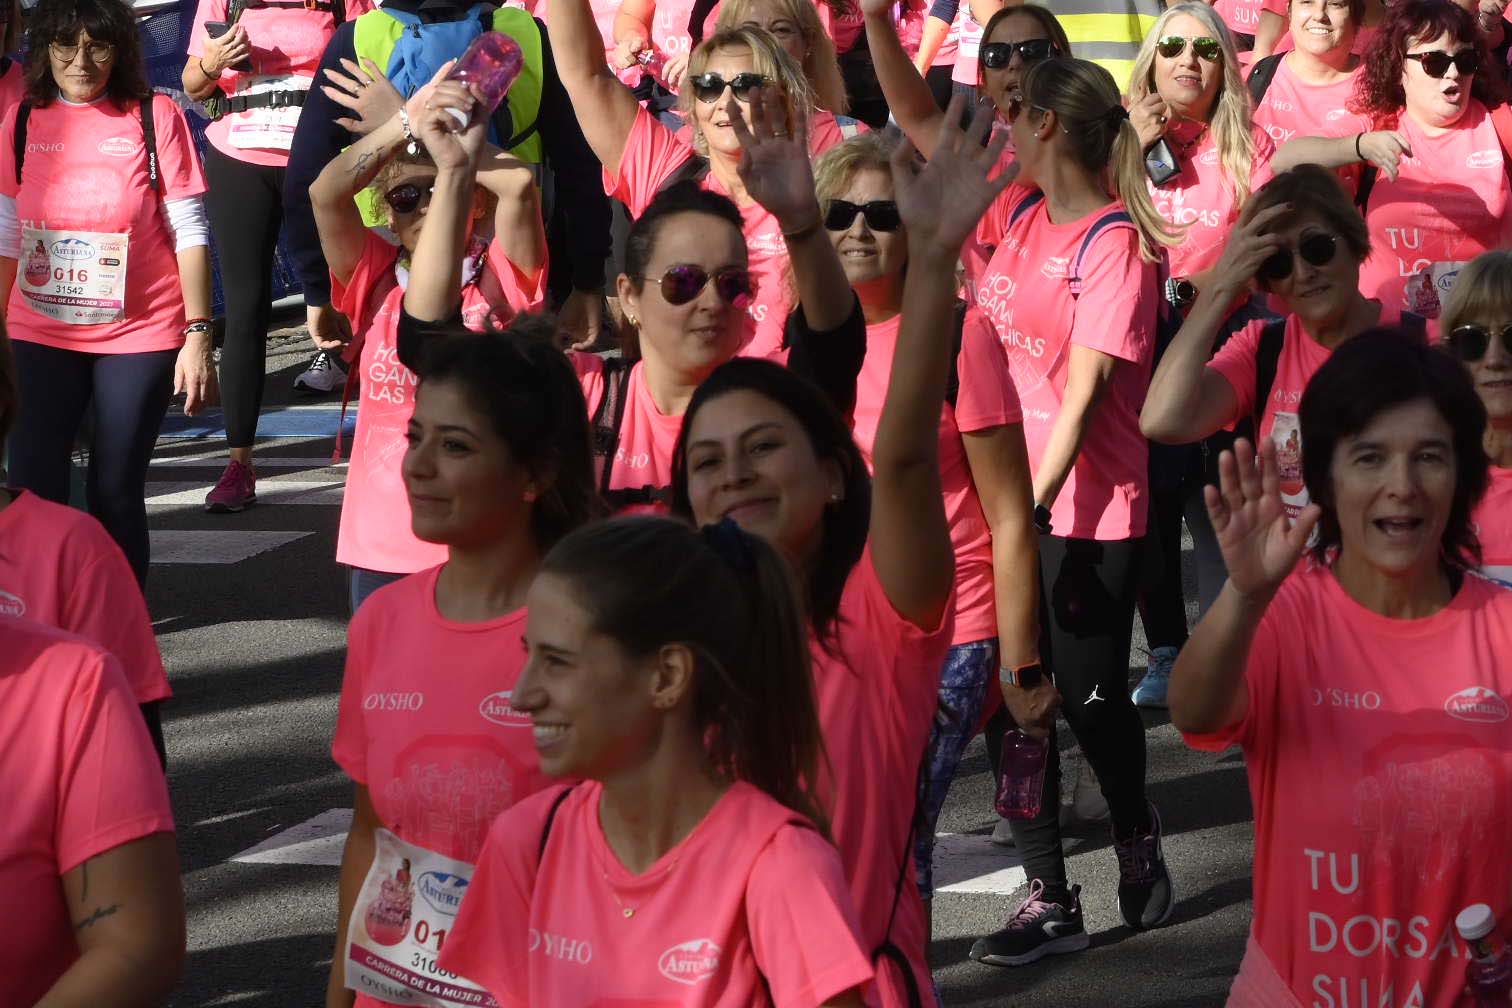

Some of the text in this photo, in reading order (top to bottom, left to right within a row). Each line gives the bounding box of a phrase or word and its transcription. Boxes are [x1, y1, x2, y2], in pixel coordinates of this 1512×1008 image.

[1385, 227, 1419, 249] TU
[54, 269, 88, 283] 016
[56, 285, 84, 295] 31542
[374, 342, 401, 366] HO
[369, 363, 418, 386] GAN
[368, 382, 405, 405] LAS
[1274, 390, 1300, 403] OYS
[363, 692, 424, 711] OYSHO
[1303, 848, 1359, 894] TU
[421, 878, 461, 906] ASTURI
[414, 920, 448, 951] 01
[1307, 912, 1472, 961] DORSA
[361, 974, 413, 999] OYSHO
[365, 955, 482, 1003] CARRERA DE LA MUJER
